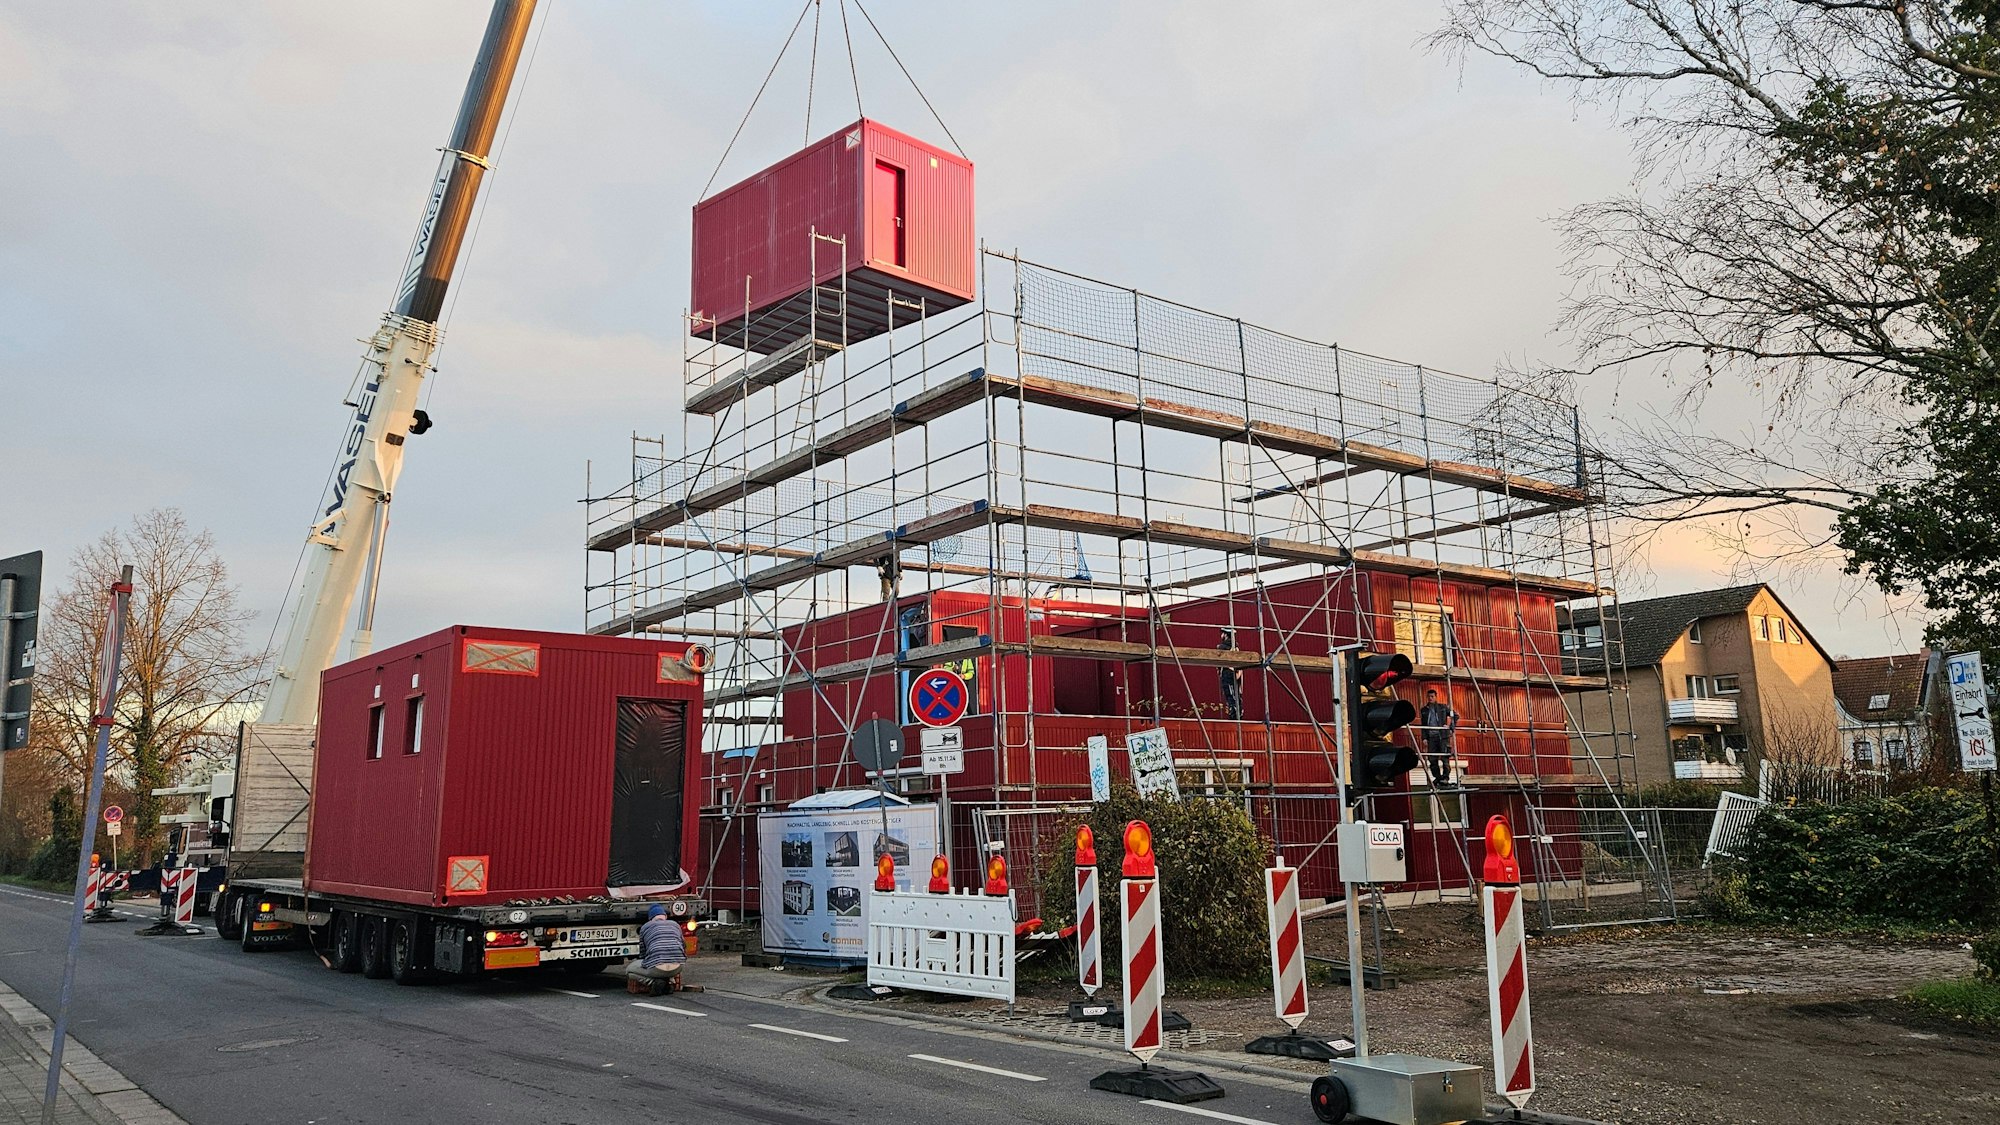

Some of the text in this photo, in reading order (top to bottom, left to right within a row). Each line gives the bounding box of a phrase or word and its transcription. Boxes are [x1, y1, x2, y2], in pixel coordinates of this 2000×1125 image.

[415, 170, 449, 257] WASEL
[1955, 688, 1983, 701] Einfahrt
[1970, 739, 1986, 757] ICI
[1373, 827, 1400, 842] LÖKA
[675, 903, 685, 913] 90
[512, 912, 523, 921] CZ
[577, 929, 614, 940] 5J3 9403
[831, 937, 863, 946] comma
[570, 947, 621, 958] SCHMITZ
